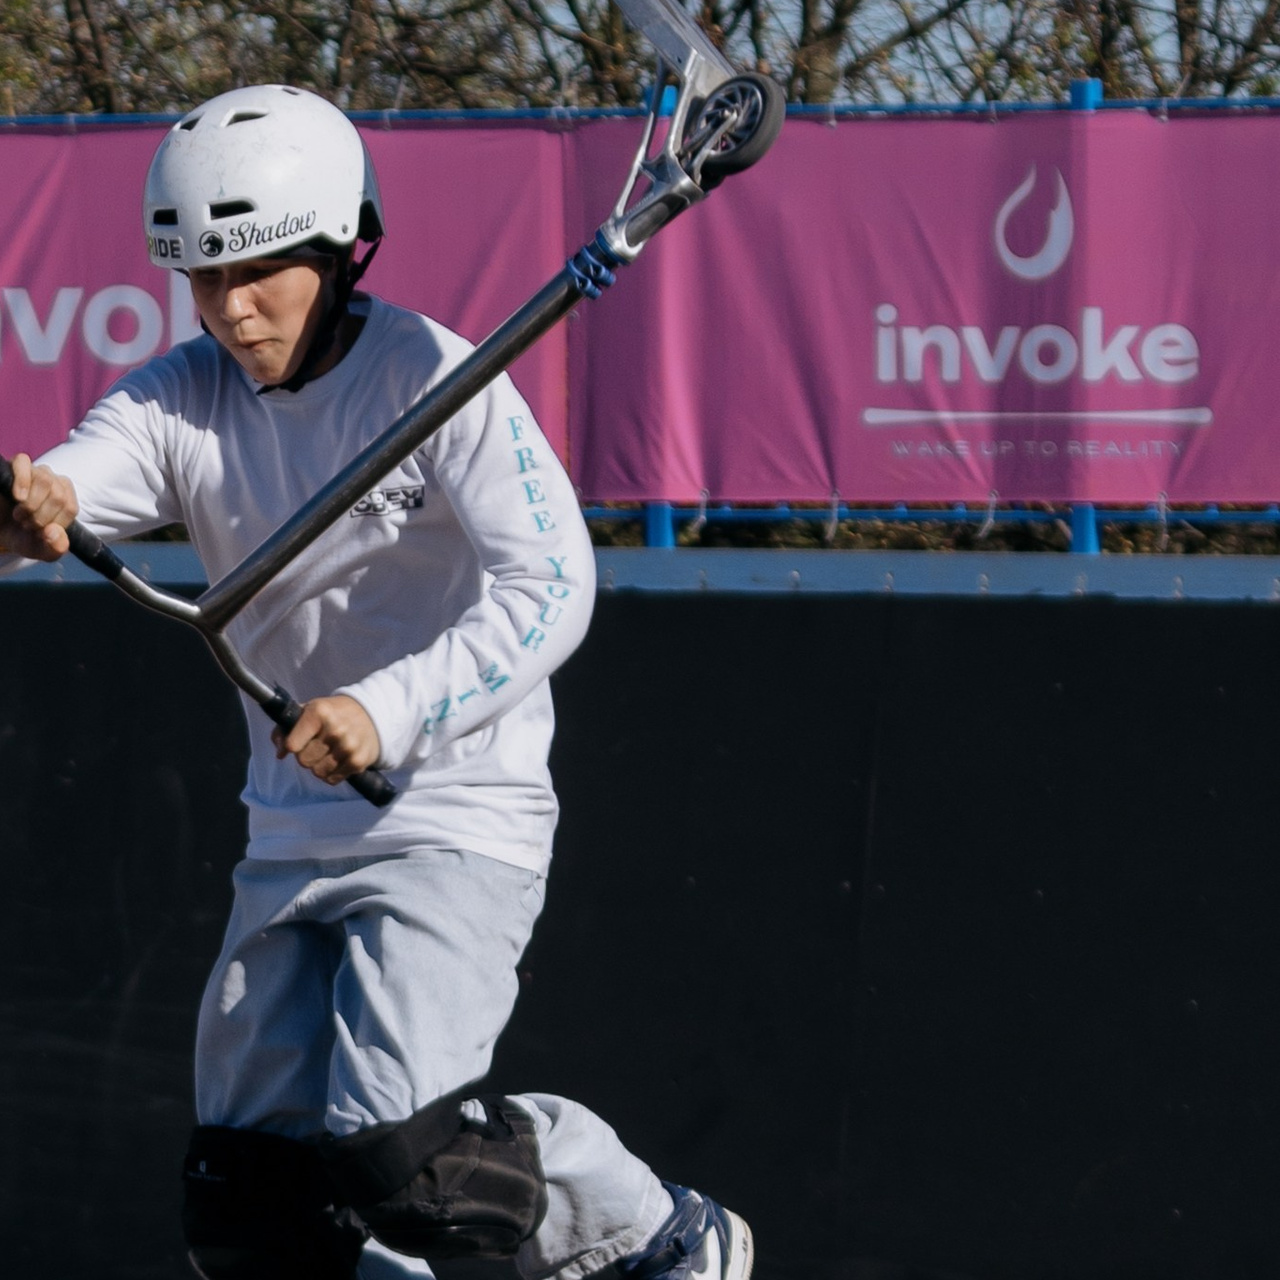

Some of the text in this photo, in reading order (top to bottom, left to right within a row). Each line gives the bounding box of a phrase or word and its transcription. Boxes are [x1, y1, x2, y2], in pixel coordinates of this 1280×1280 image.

[228, 210, 317, 252] Shadow
[875, 303, 1200, 383] invoke
[507, 415, 557, 534] FREE
[892, 440, 1185, 457] WAKE UP TO REALITY
[520, 555, 570, 655] YOUR
